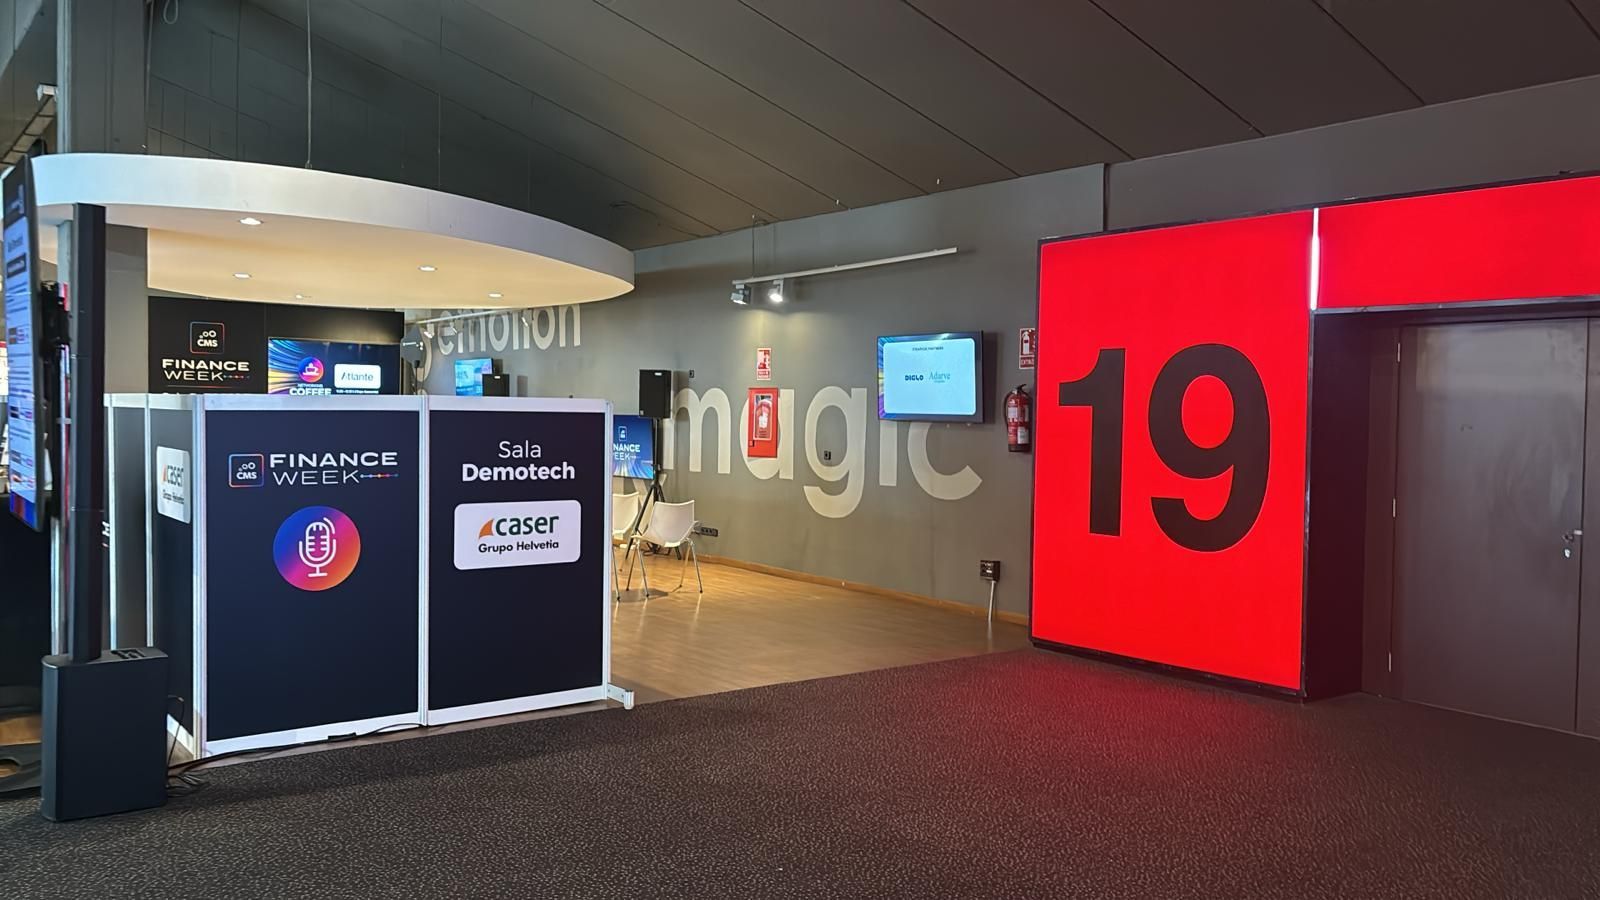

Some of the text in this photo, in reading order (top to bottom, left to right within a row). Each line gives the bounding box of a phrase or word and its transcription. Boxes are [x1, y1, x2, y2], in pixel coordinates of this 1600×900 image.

[197, 339, 218, 347] CMS
[162, 359, 250, 371] FINANCE
[164, 370, 224, 381] WEEK
[498, 439, 542, 458] Sala
[613, 443, 641, 453] NANCE
[1058, 343, 1271, 553] 19
[269, 452, 398, 468] FINANCE
[613, 452, 630, 460] EEK
[236, 471, 258, 480] CMS
[272, 470, 360, 485] WEEK
[462, 461, 575, 482] Demotech
[495, 515, 560, 537] caser
[478, 540, 559, 555] Grupo Helvetia
